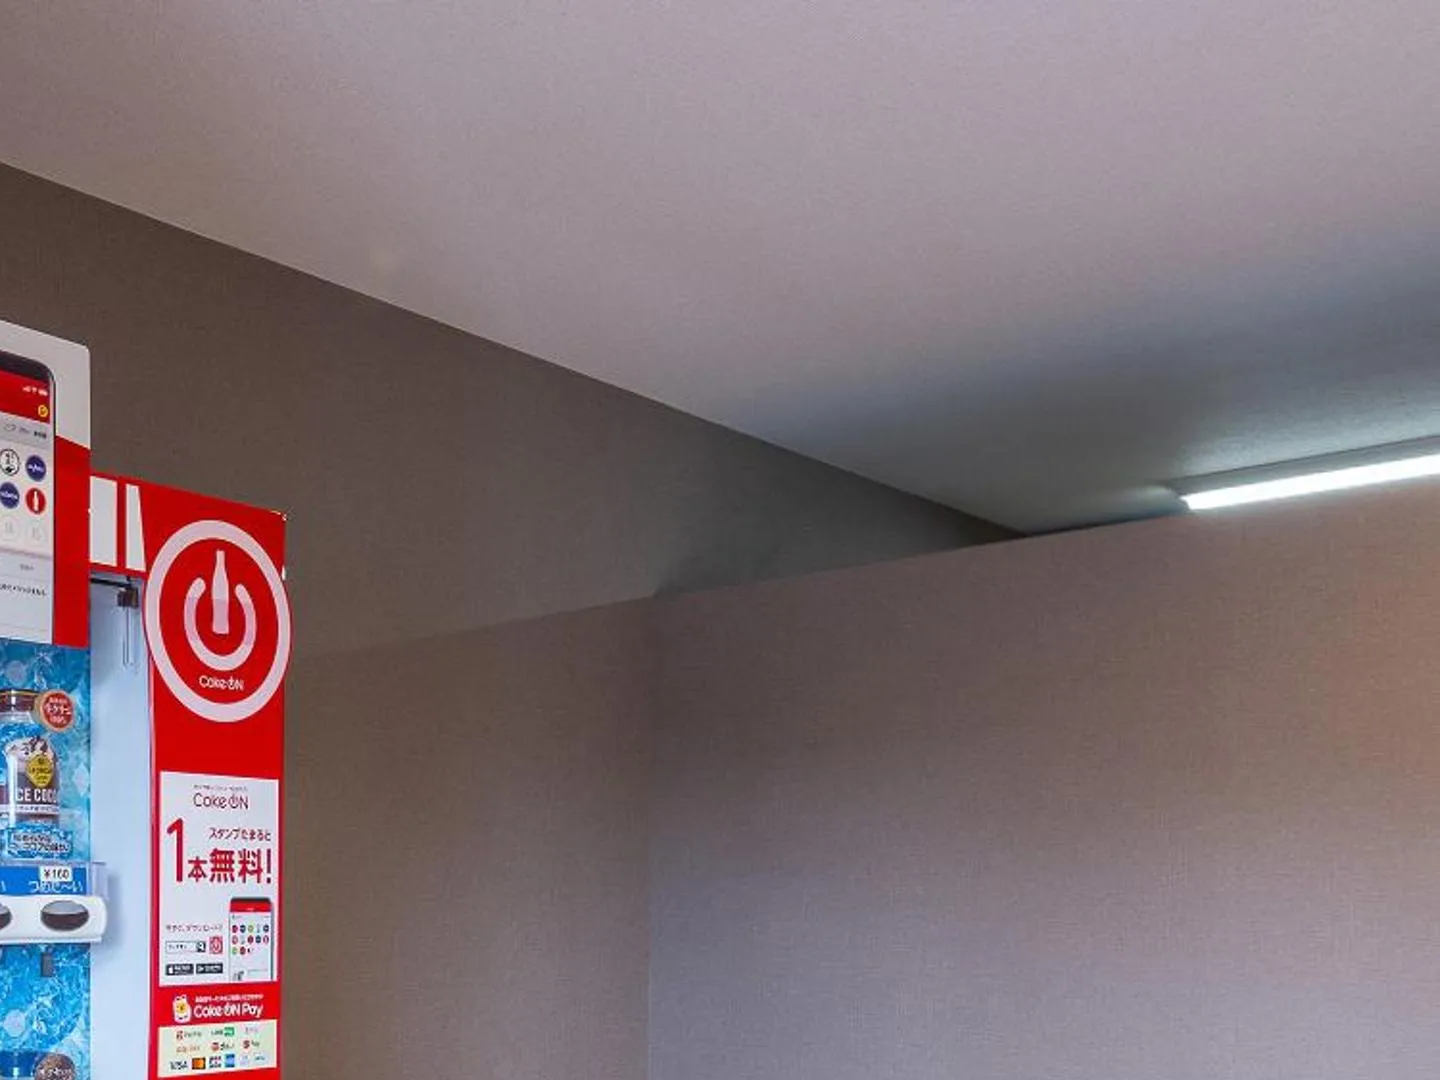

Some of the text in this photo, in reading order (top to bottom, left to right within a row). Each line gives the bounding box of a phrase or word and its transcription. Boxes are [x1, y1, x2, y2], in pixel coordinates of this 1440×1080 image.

[193, 792, 228, 810] Coke
[166, 817, 273, 885] 1本無料!
[241, 1002, 264, 1018] Pay
